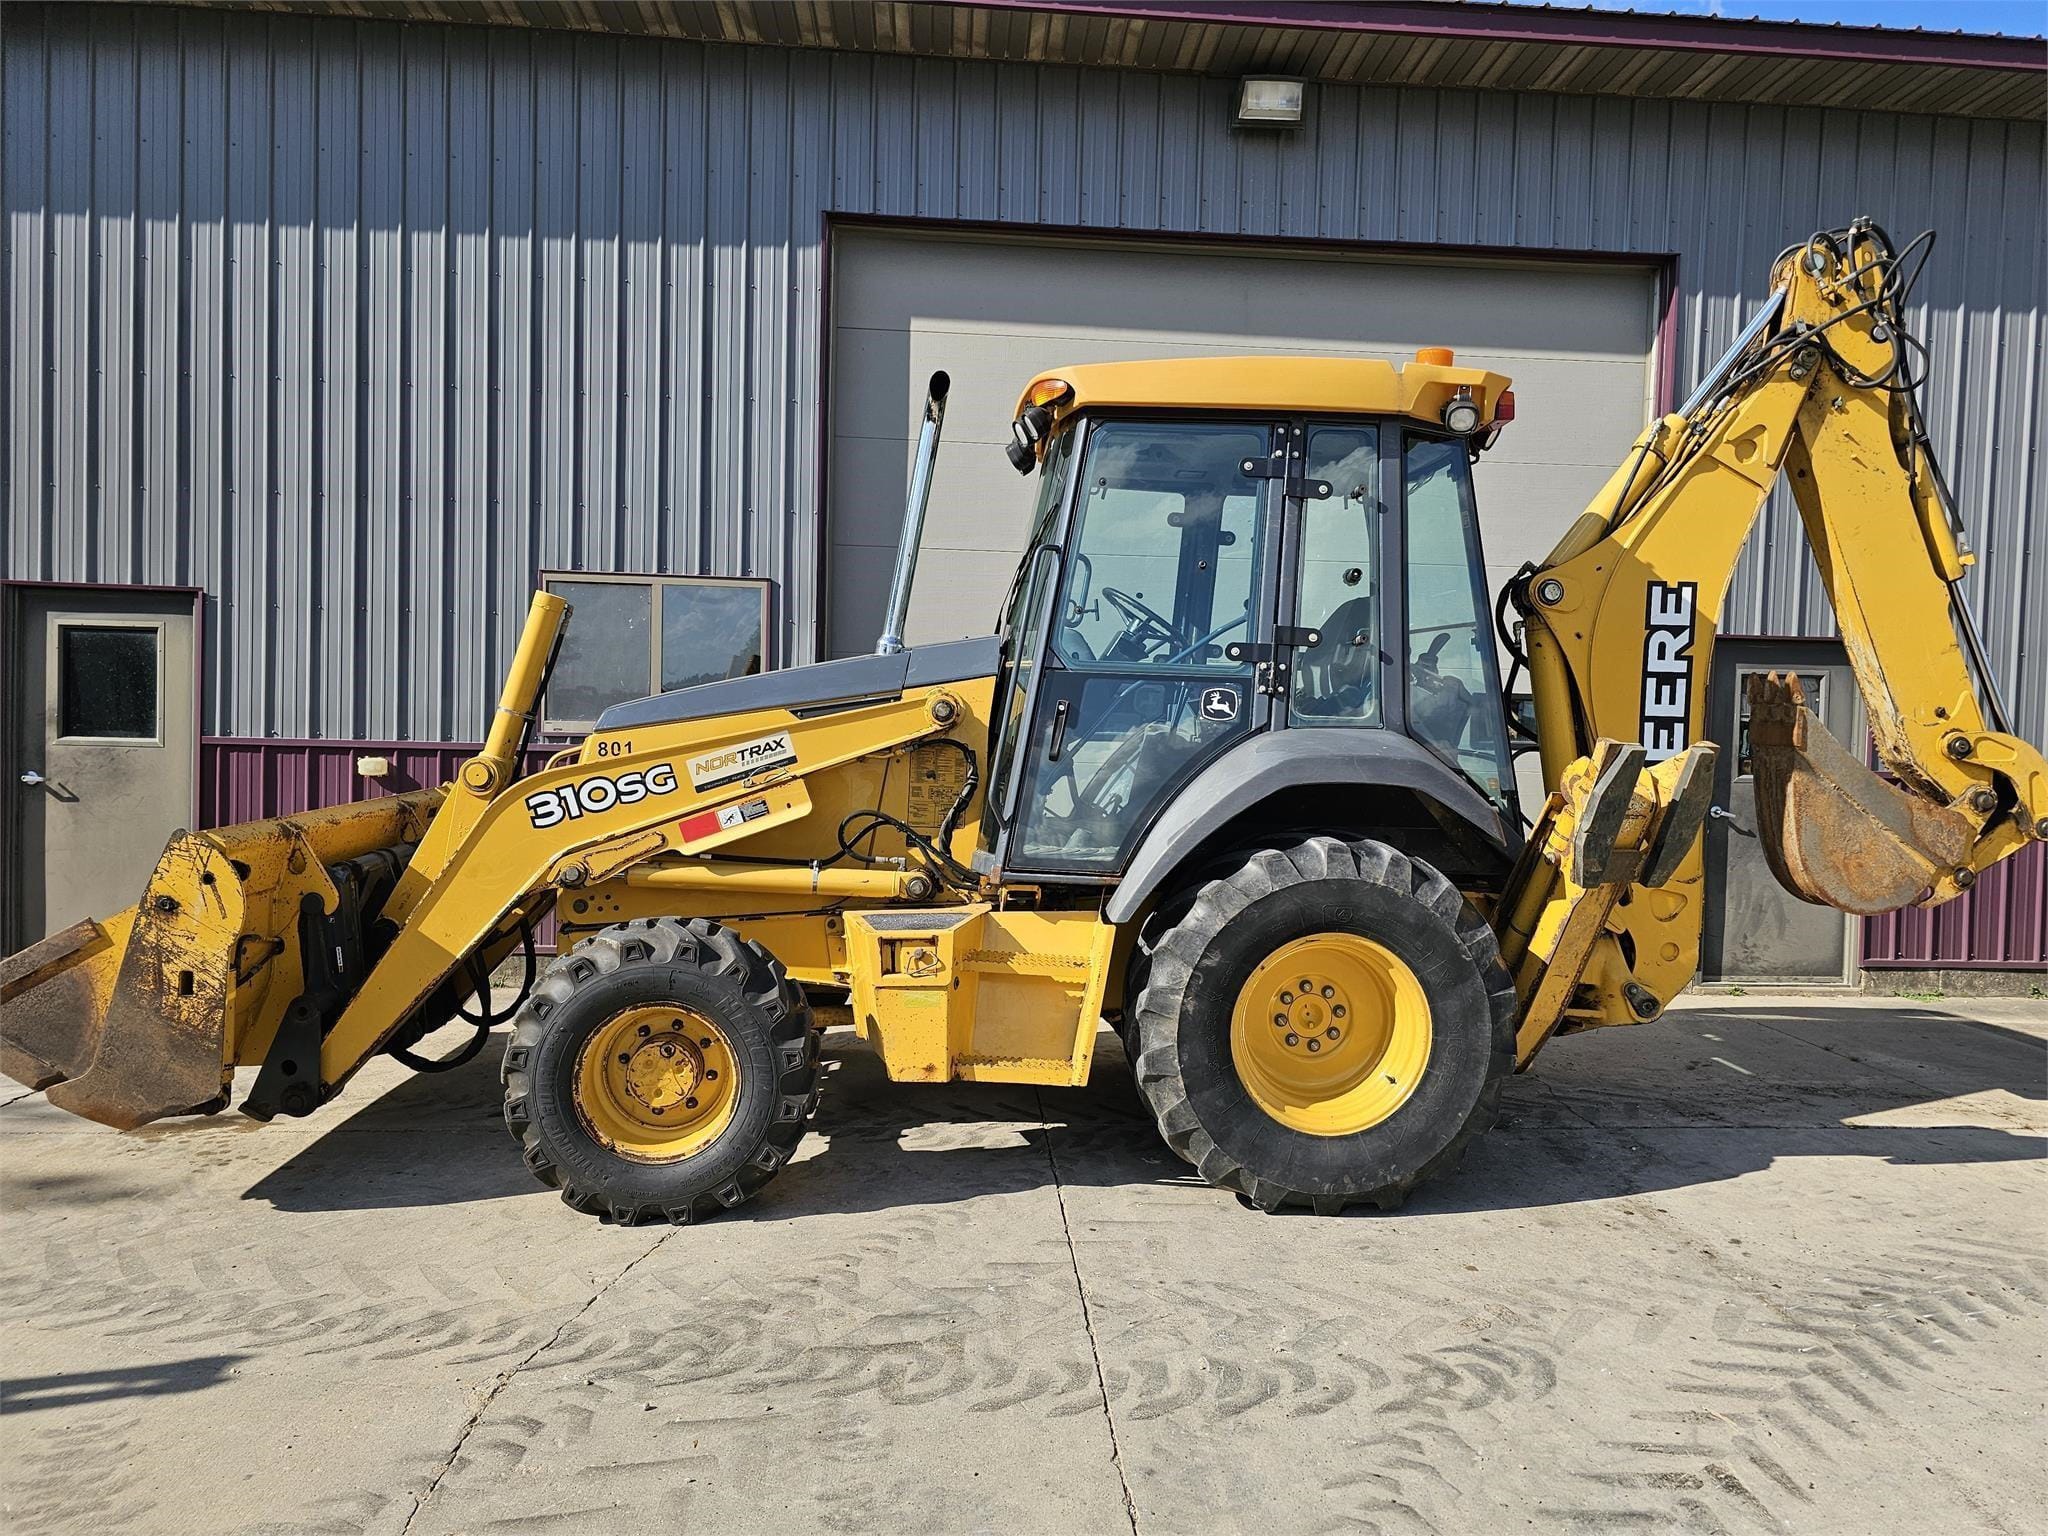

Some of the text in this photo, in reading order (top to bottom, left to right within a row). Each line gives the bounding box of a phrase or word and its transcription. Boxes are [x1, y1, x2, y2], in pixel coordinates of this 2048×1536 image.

[1639, 581, 1697, 768] EERE
[597, 740, 633, 757] 801
[695, 737, 786, 776] NORTRAX
[525, 763, 679, 828] 310SG
